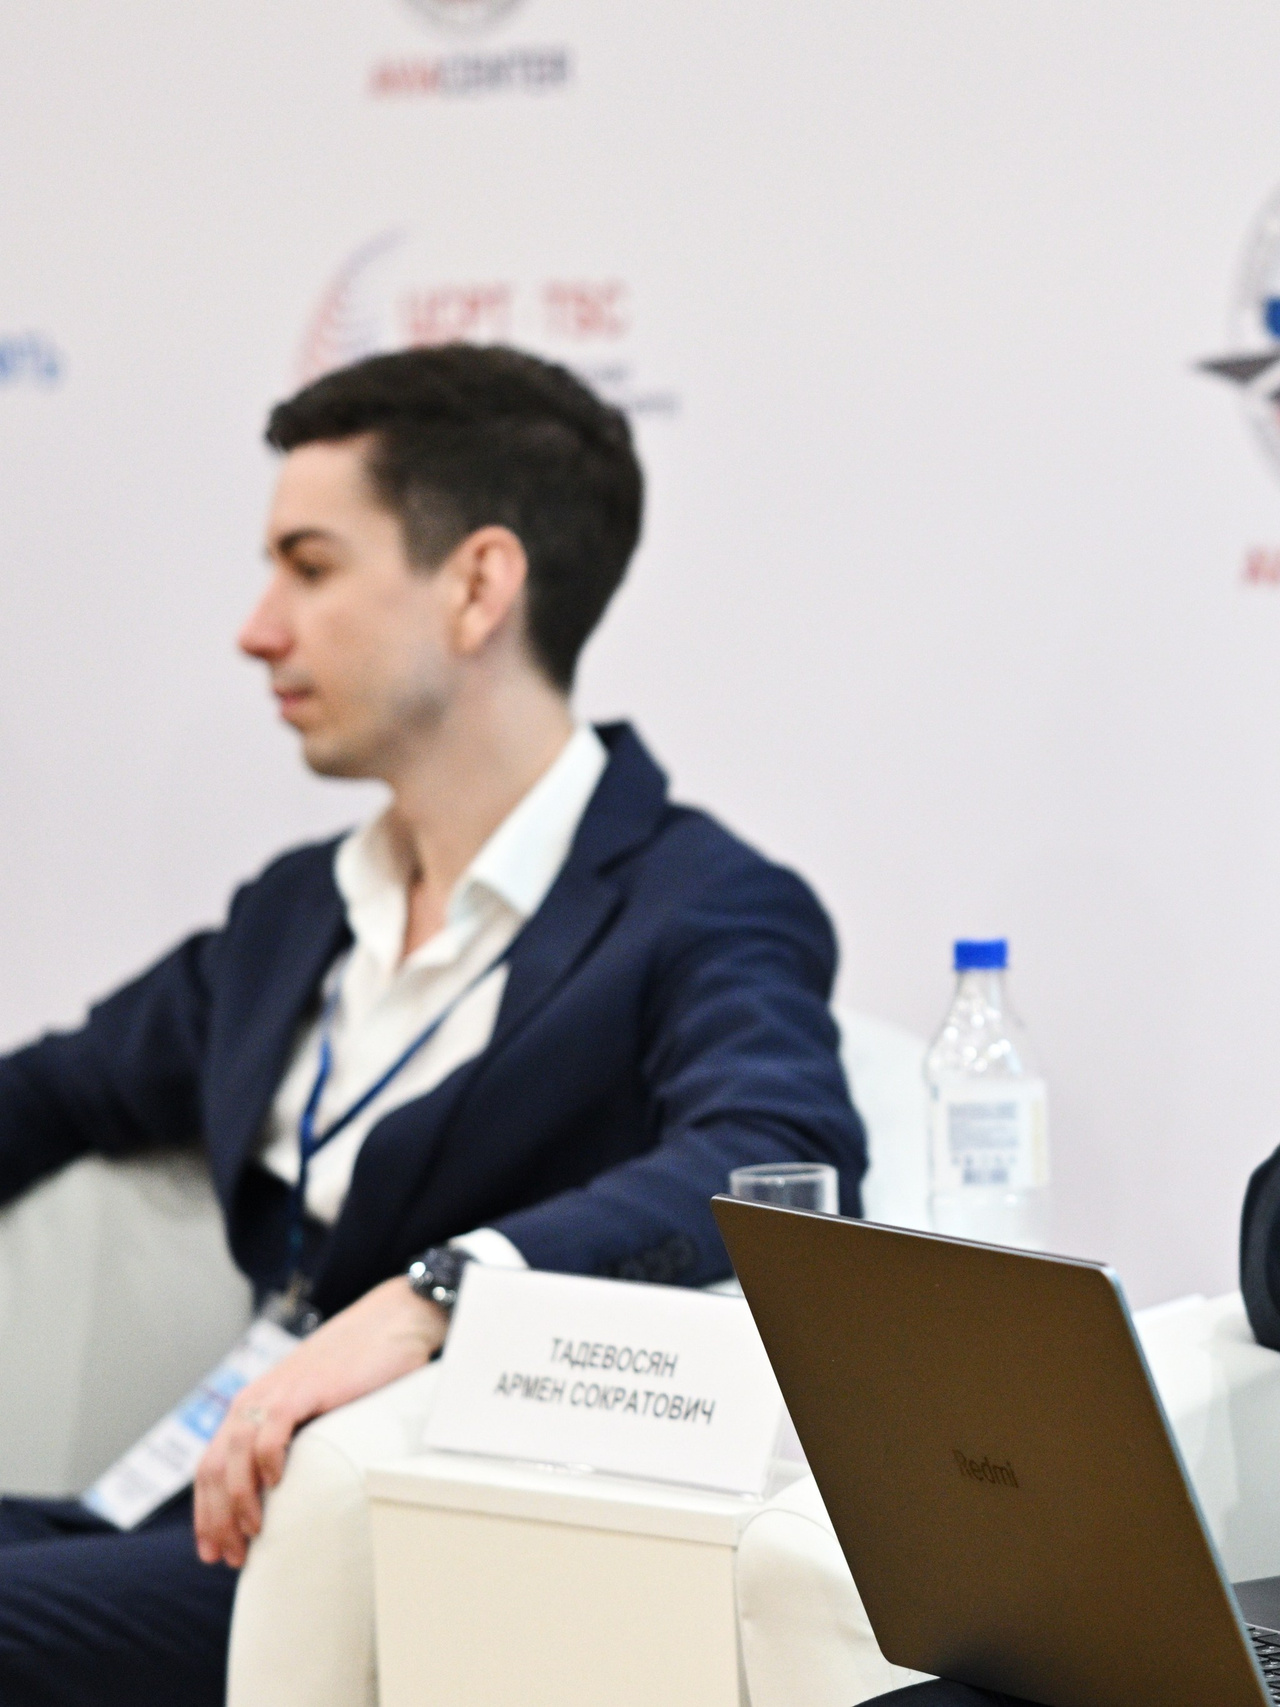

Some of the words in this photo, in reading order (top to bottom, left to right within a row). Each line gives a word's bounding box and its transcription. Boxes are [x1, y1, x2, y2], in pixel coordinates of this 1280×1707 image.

[551, 1337, 678, 1378] ТАДЕВОСЯН
[495, 1371, 567, 1404] АРМЕН
[569, 1381, 716, 1425] СОКРАТОВИЧ
[952, 1449, 1019, 1489] Redmi
